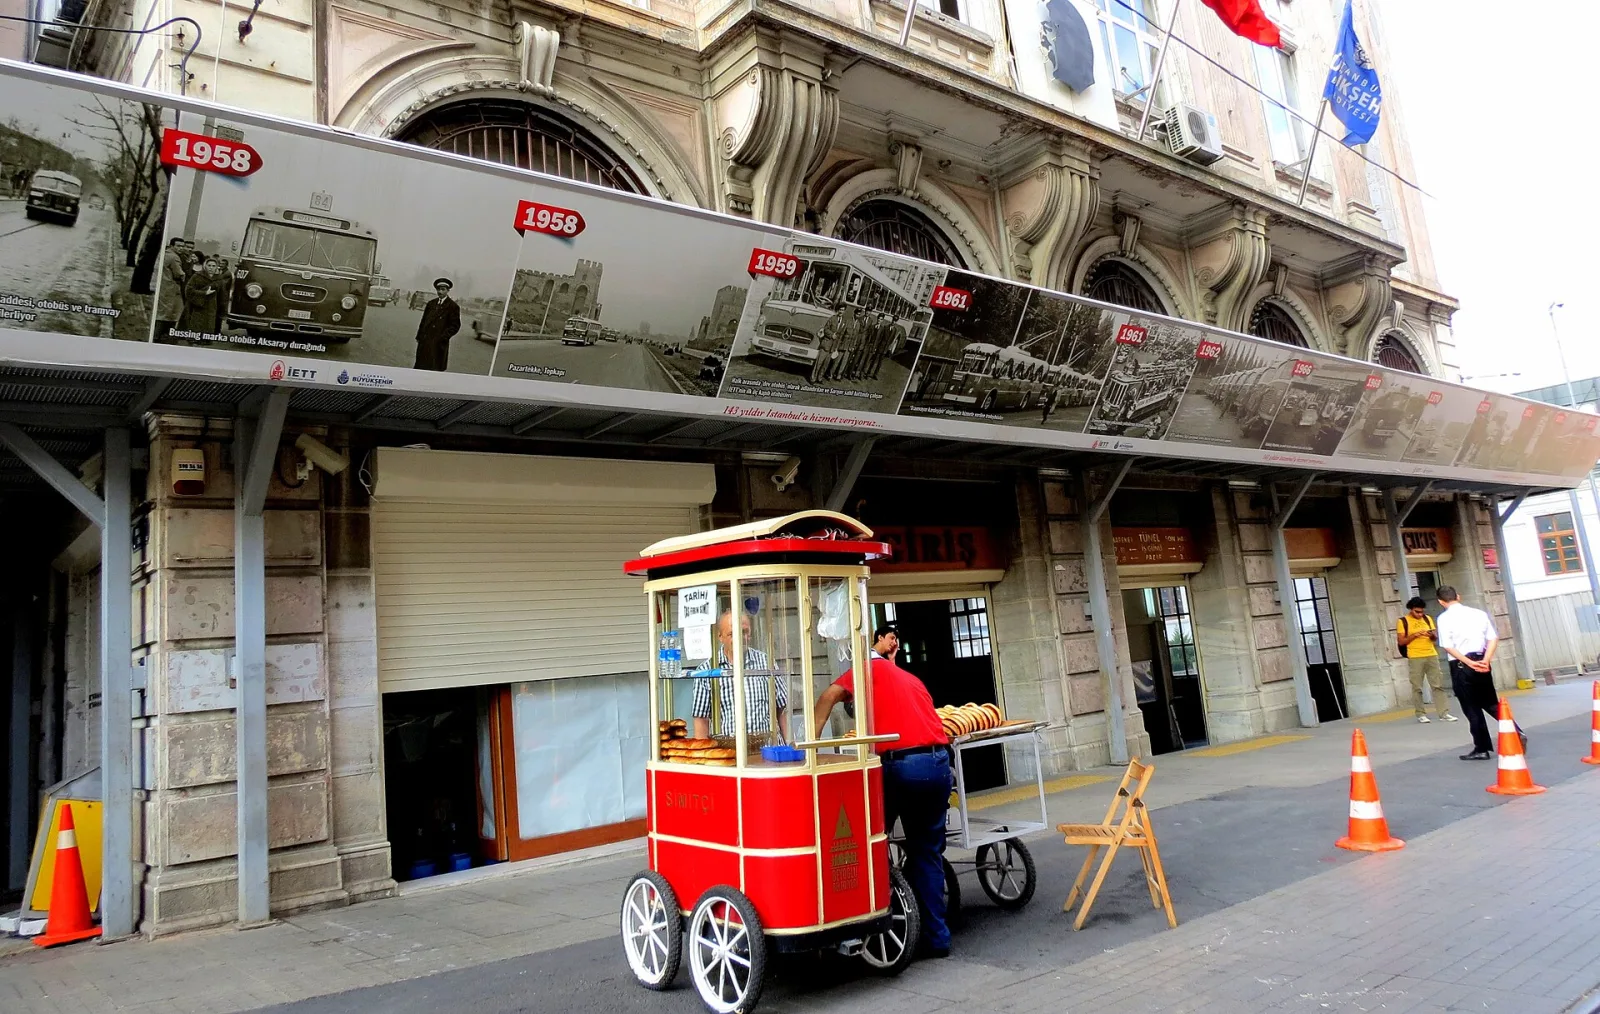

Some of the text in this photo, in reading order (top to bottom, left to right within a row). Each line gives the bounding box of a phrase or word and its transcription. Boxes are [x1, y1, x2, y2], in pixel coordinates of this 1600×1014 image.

[173, 137, 251, 172] 1958
[314, 195, 329, 208] 84
[523, 207, 578, 234] 1958
[754, 253, 797, 276] 1959
[935, 290, 968, 309] 1961
[37, 301, 69, 311] otobüs
[84, 305, 121, 318] tramvay
[169, 327, 326, 353] Bussing marka otobüs Aksaray durağında
[1120, 327, 1144, 343] 1961
[1199, 343, 1221, 358] 1962
[287, 366, 317, 379] İETT
[723, 405, 884, 428] 143 yıldır İstanbul'a hizmet veriyoruz...
[1139, 532, 1161, 542] TÜNEL
[1402, 531, 1438, 553] ÇIKIŞ
[684, 589, 709, 602] TARİHİ
[665, 790, 715, 816] SİMİTÇİ
